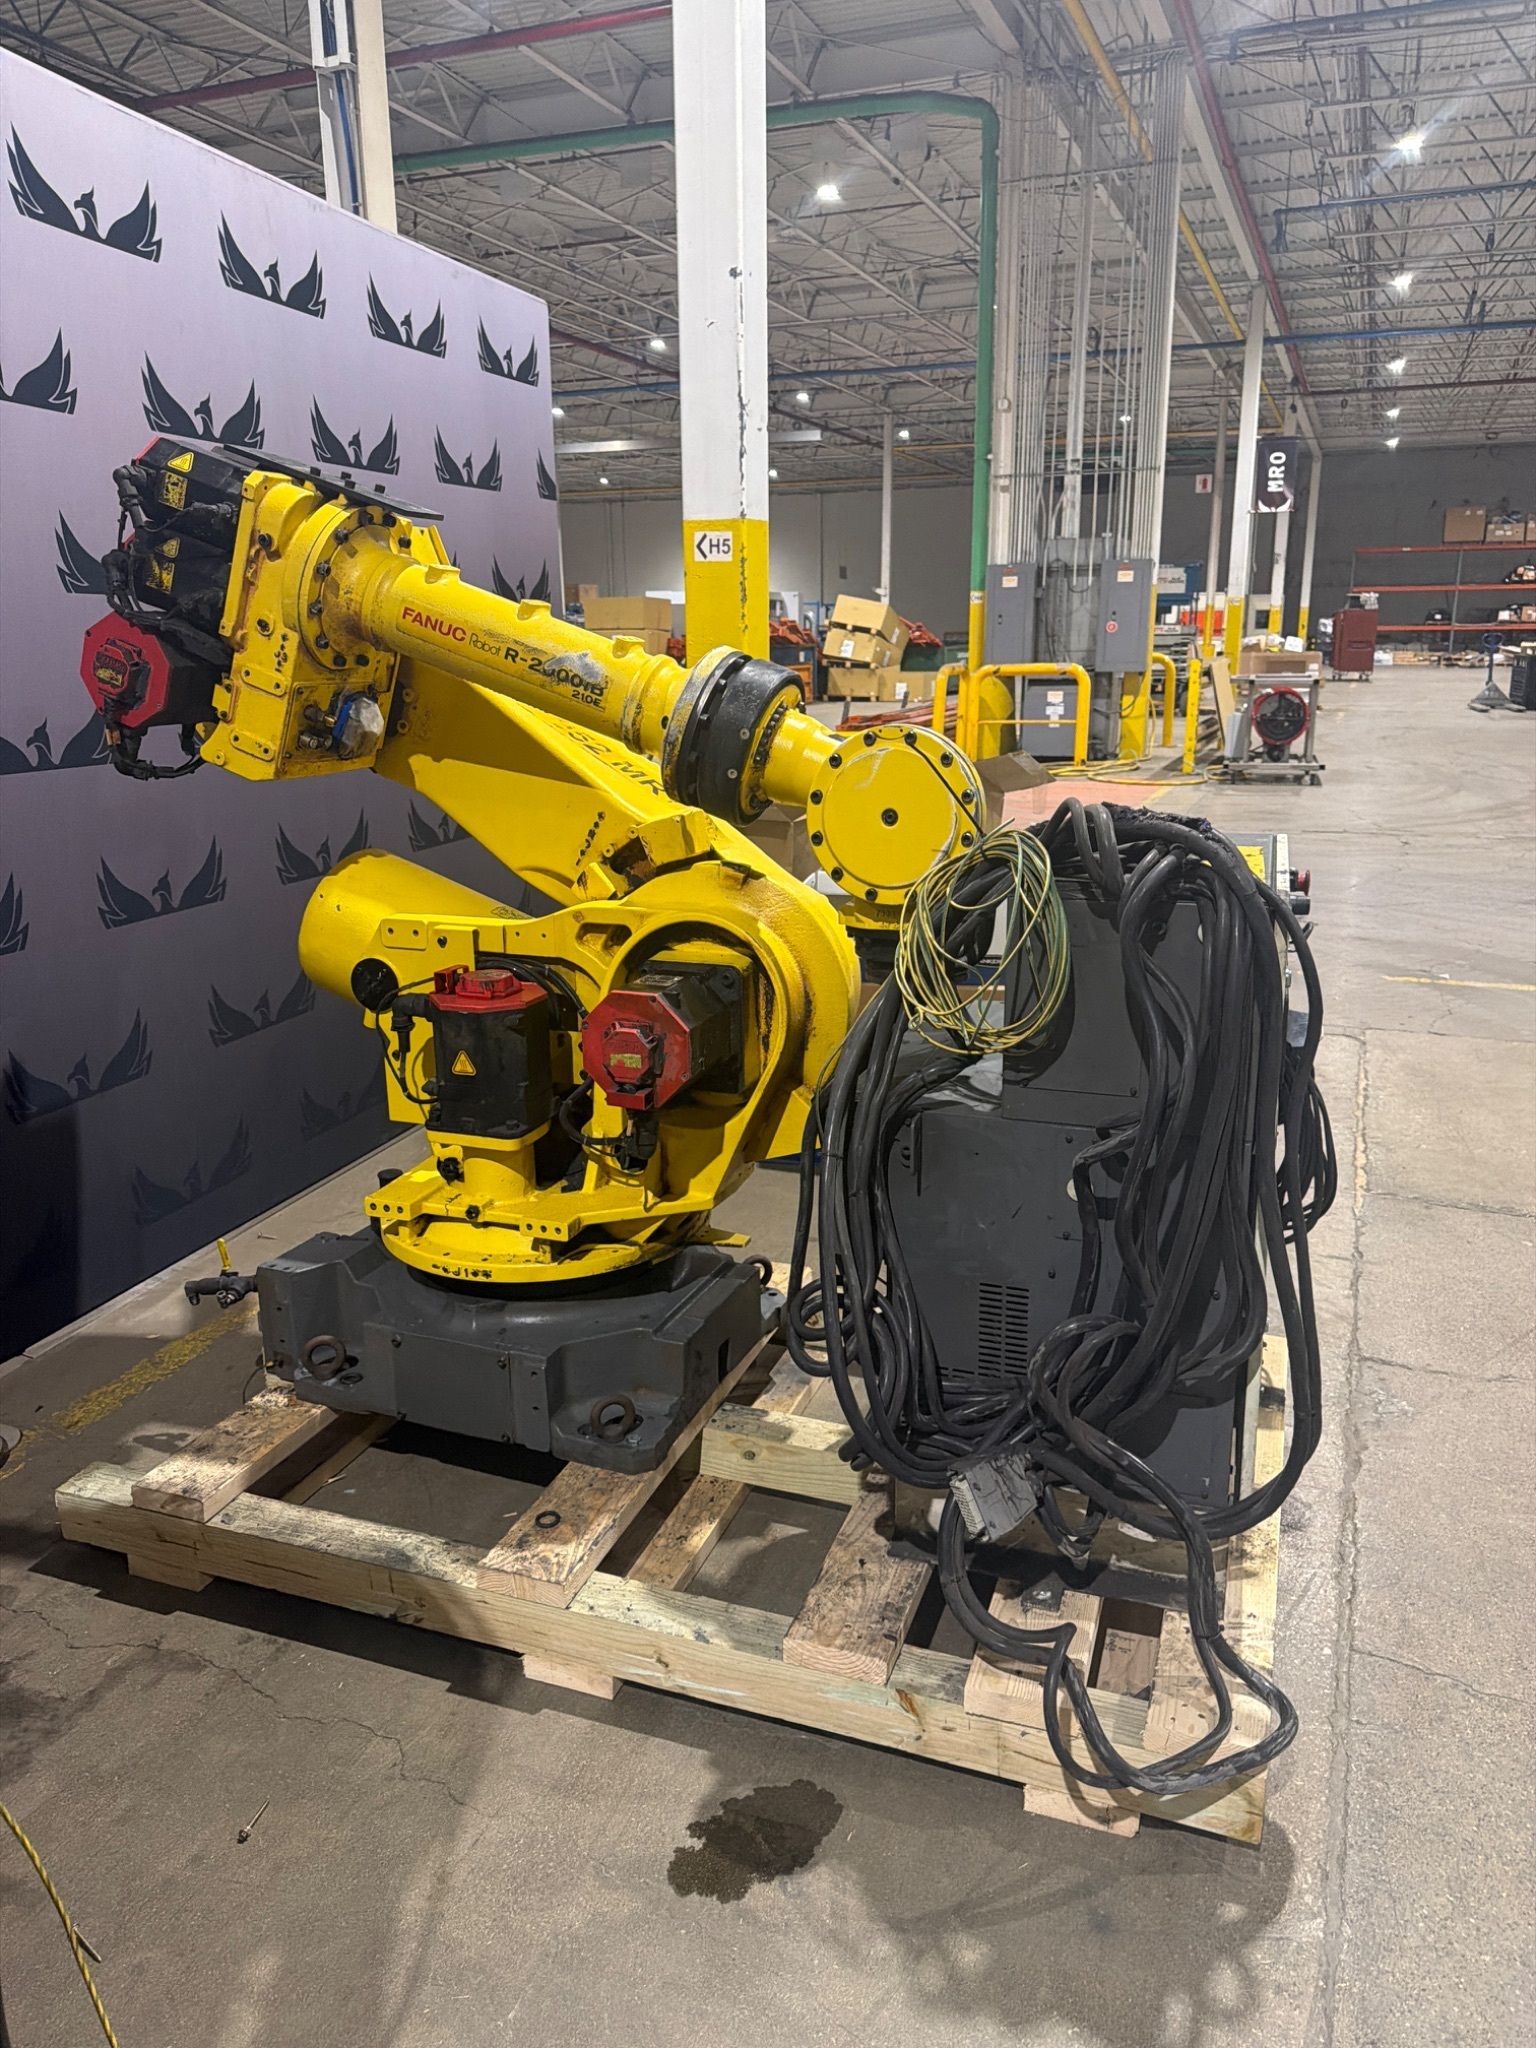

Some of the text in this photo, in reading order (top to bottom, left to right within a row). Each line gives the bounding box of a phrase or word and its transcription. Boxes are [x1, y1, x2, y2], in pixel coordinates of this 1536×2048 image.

[1267, 452, 1286, 493] MRO
[709, 538, 731, 554] H5
[402, 606, 467, 642] FANUC
[469, 633, 502, 656] Robot
